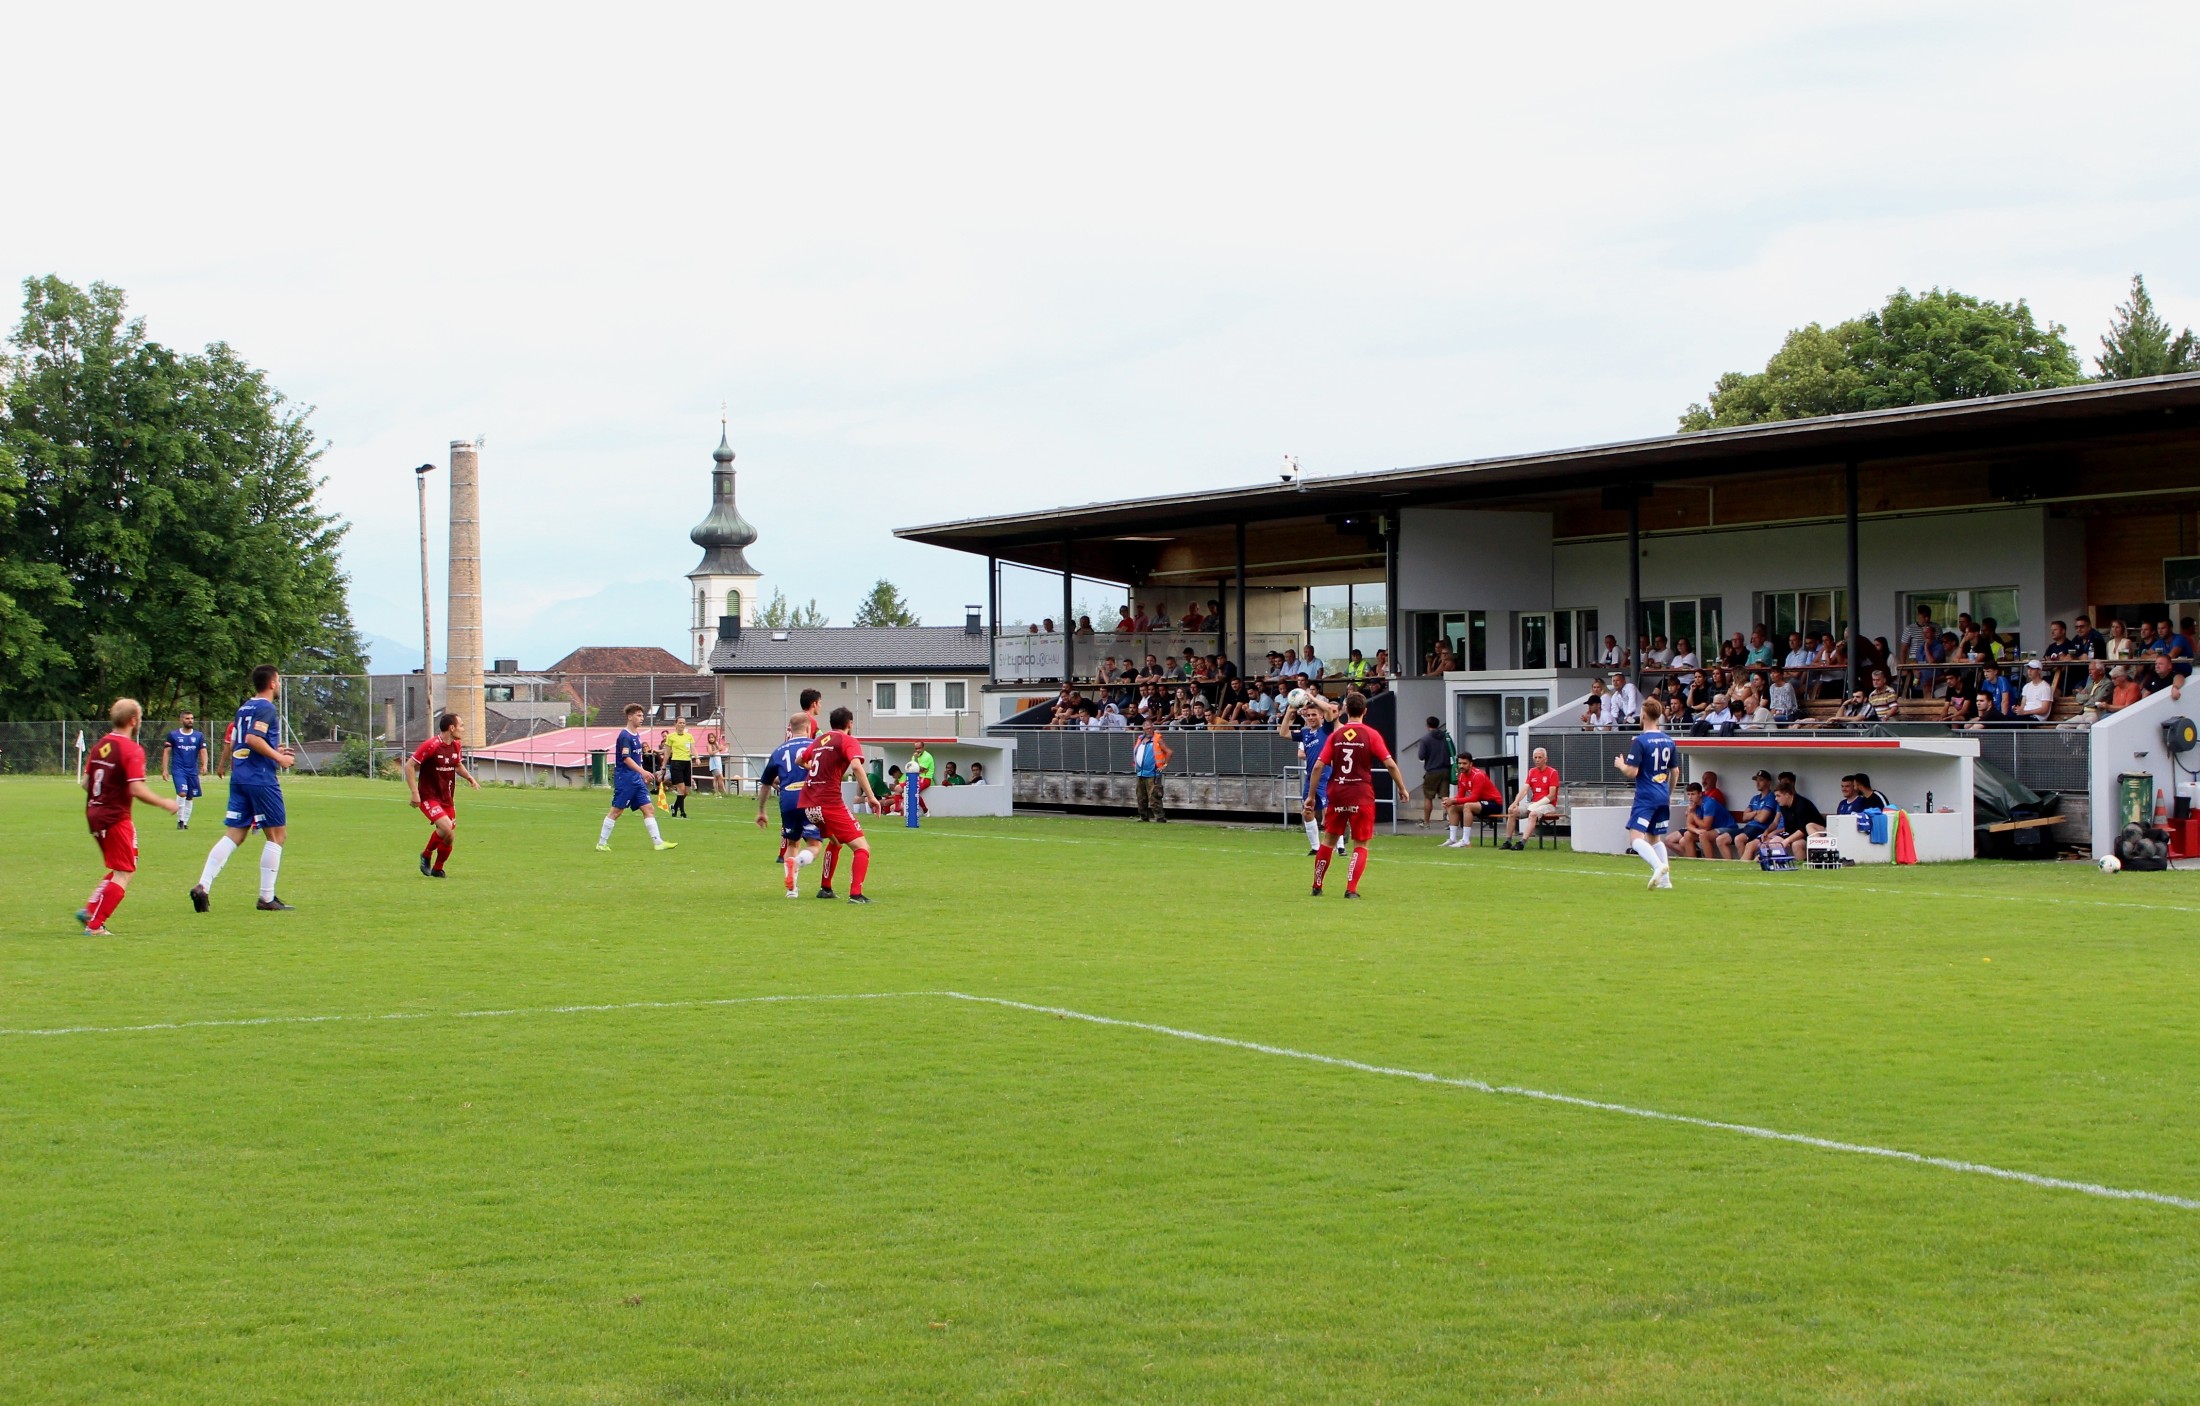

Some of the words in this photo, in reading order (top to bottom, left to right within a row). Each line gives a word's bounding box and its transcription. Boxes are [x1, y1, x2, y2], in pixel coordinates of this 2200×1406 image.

[809, 752, 822, 777] 5
[1341, 748, 1354, 774] 3
[1651, 747, 1671, 771] 19
[93, 768, 105, 797] 8
